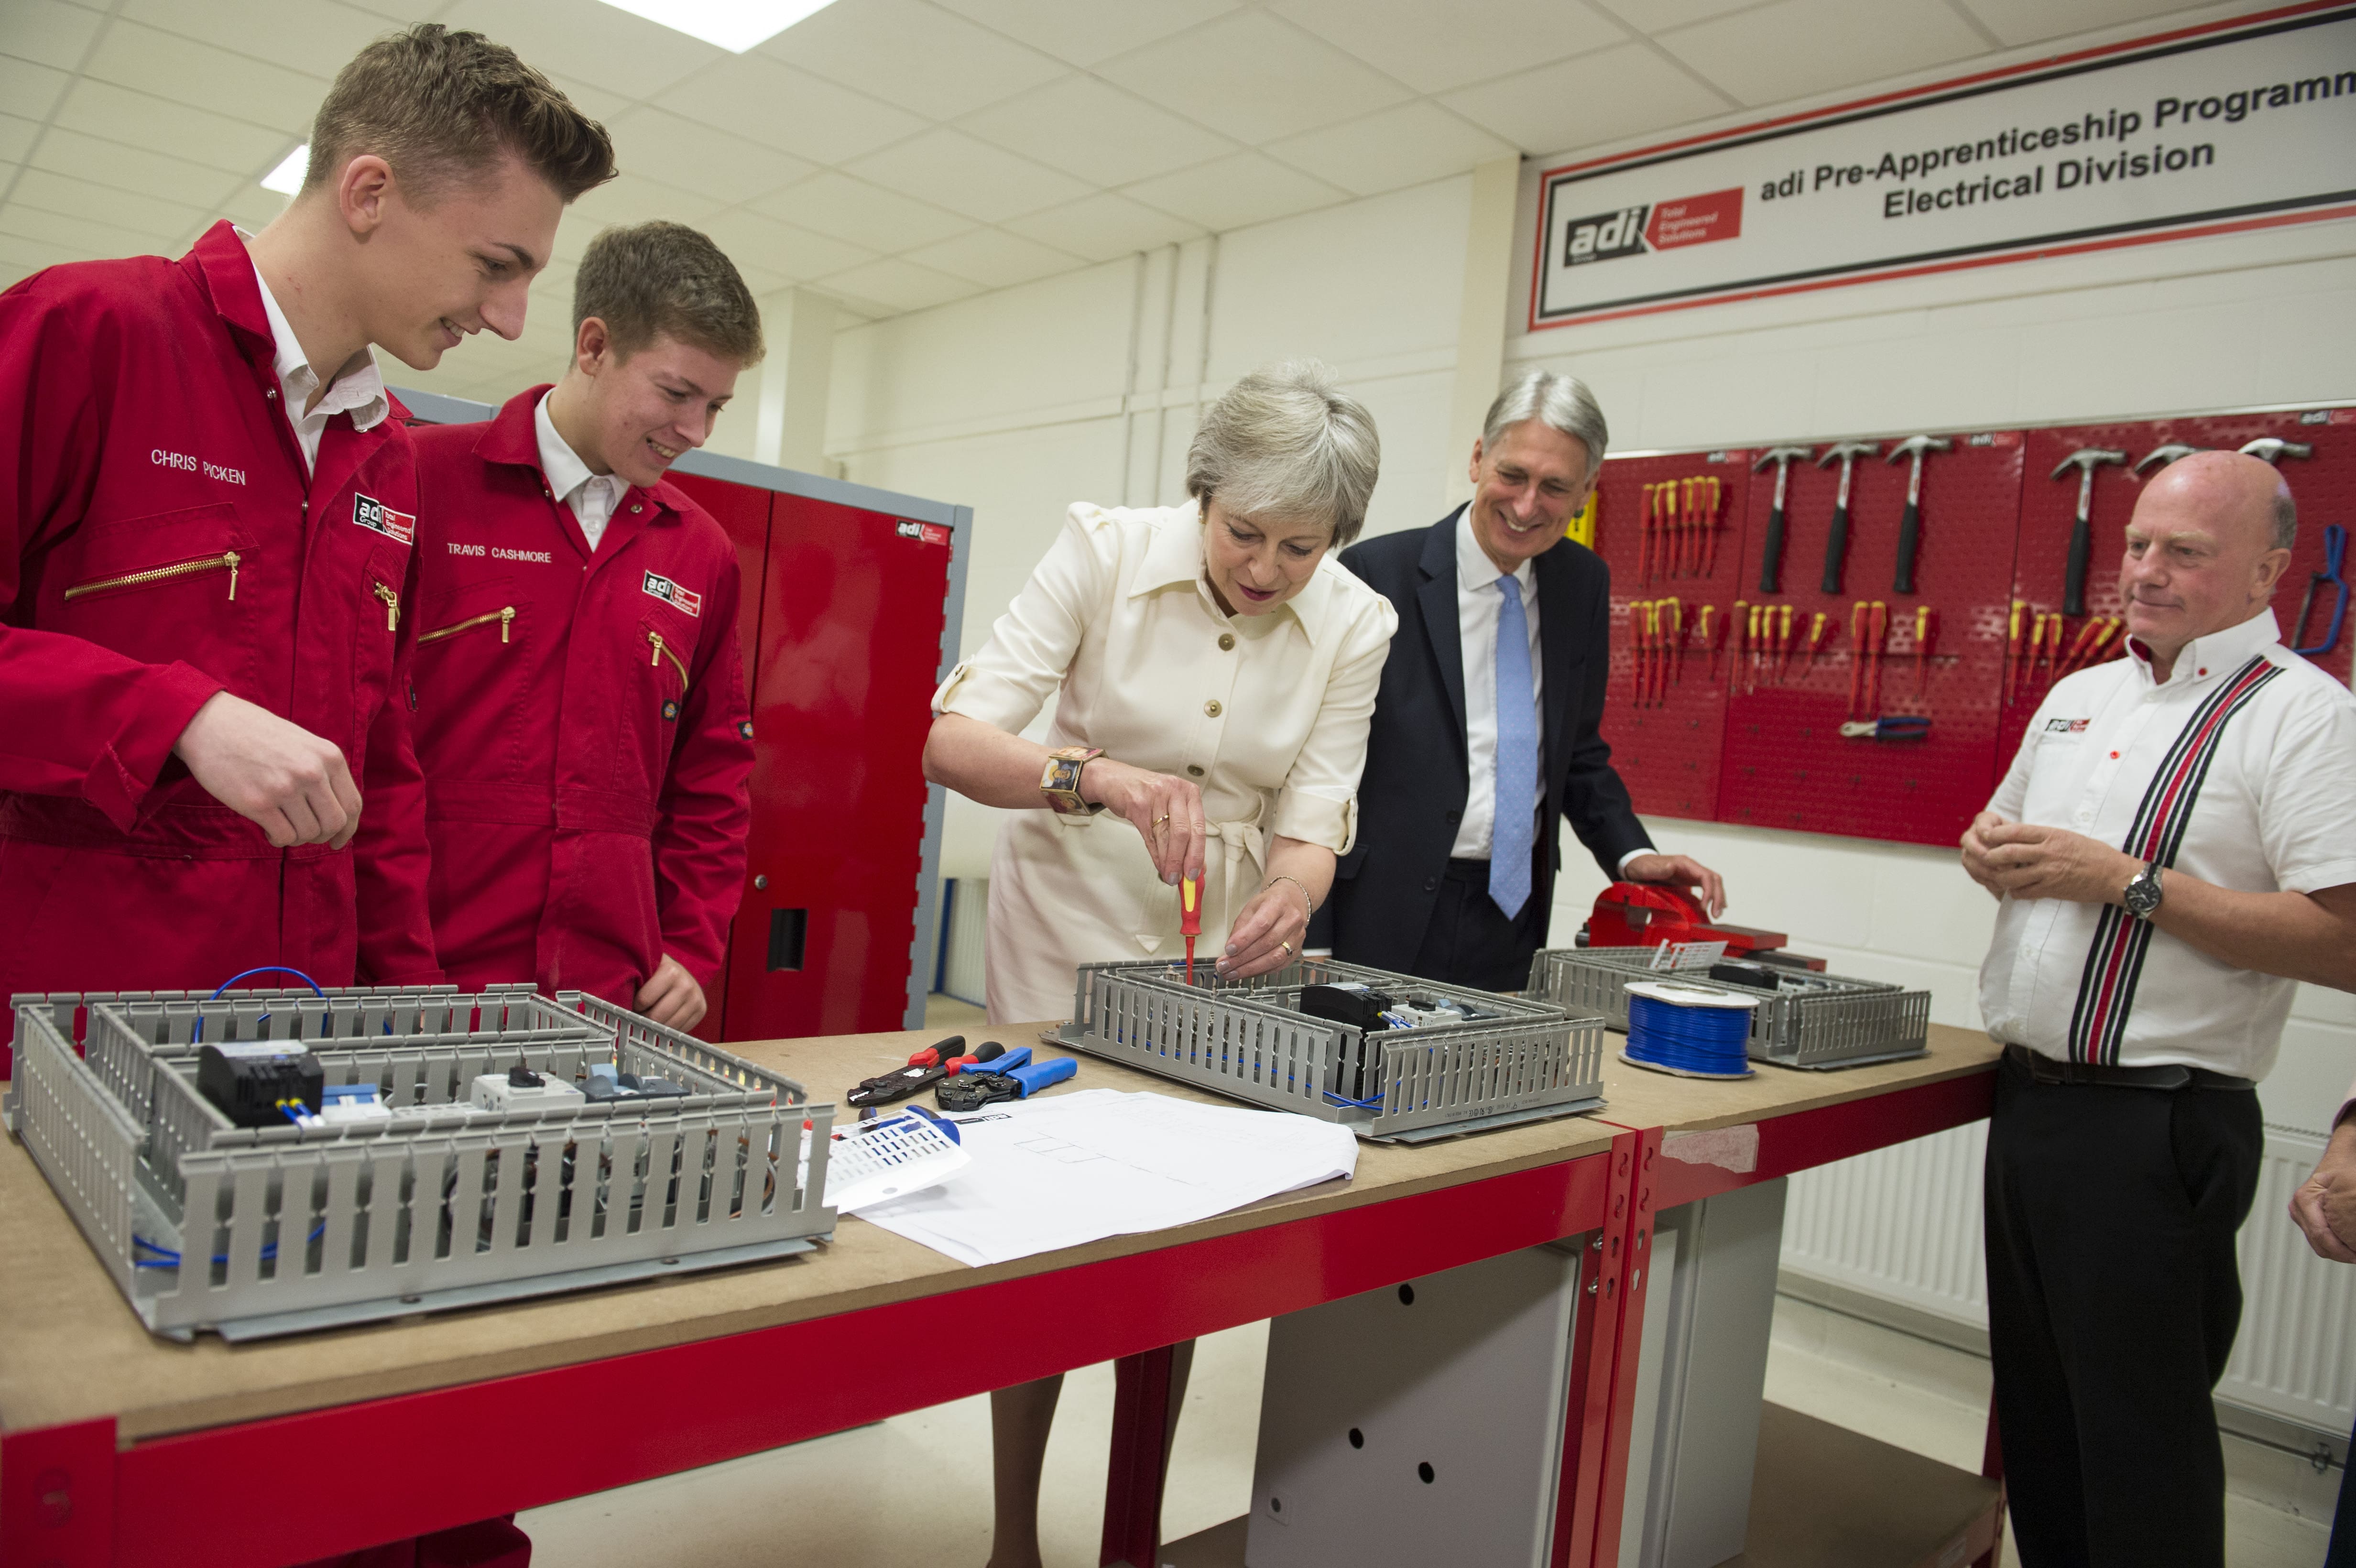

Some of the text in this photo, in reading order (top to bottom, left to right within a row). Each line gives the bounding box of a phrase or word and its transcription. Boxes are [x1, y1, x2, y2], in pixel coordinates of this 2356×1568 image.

[1761, 170, 1804, 201] adi
[1814, 109, 2141, 191] Pre-Apprenticeship
[1884, 143, 2214, 218] Electrical Division
[1569, 207, 1641, 255] adi
[151, 449, 246, 486] CHRIS PICKEN
[360, 516, 377, 527] Group
[447, 543, 551, 563] TRAVIS CASHMORE
[647, 577, 671, 595] adi
